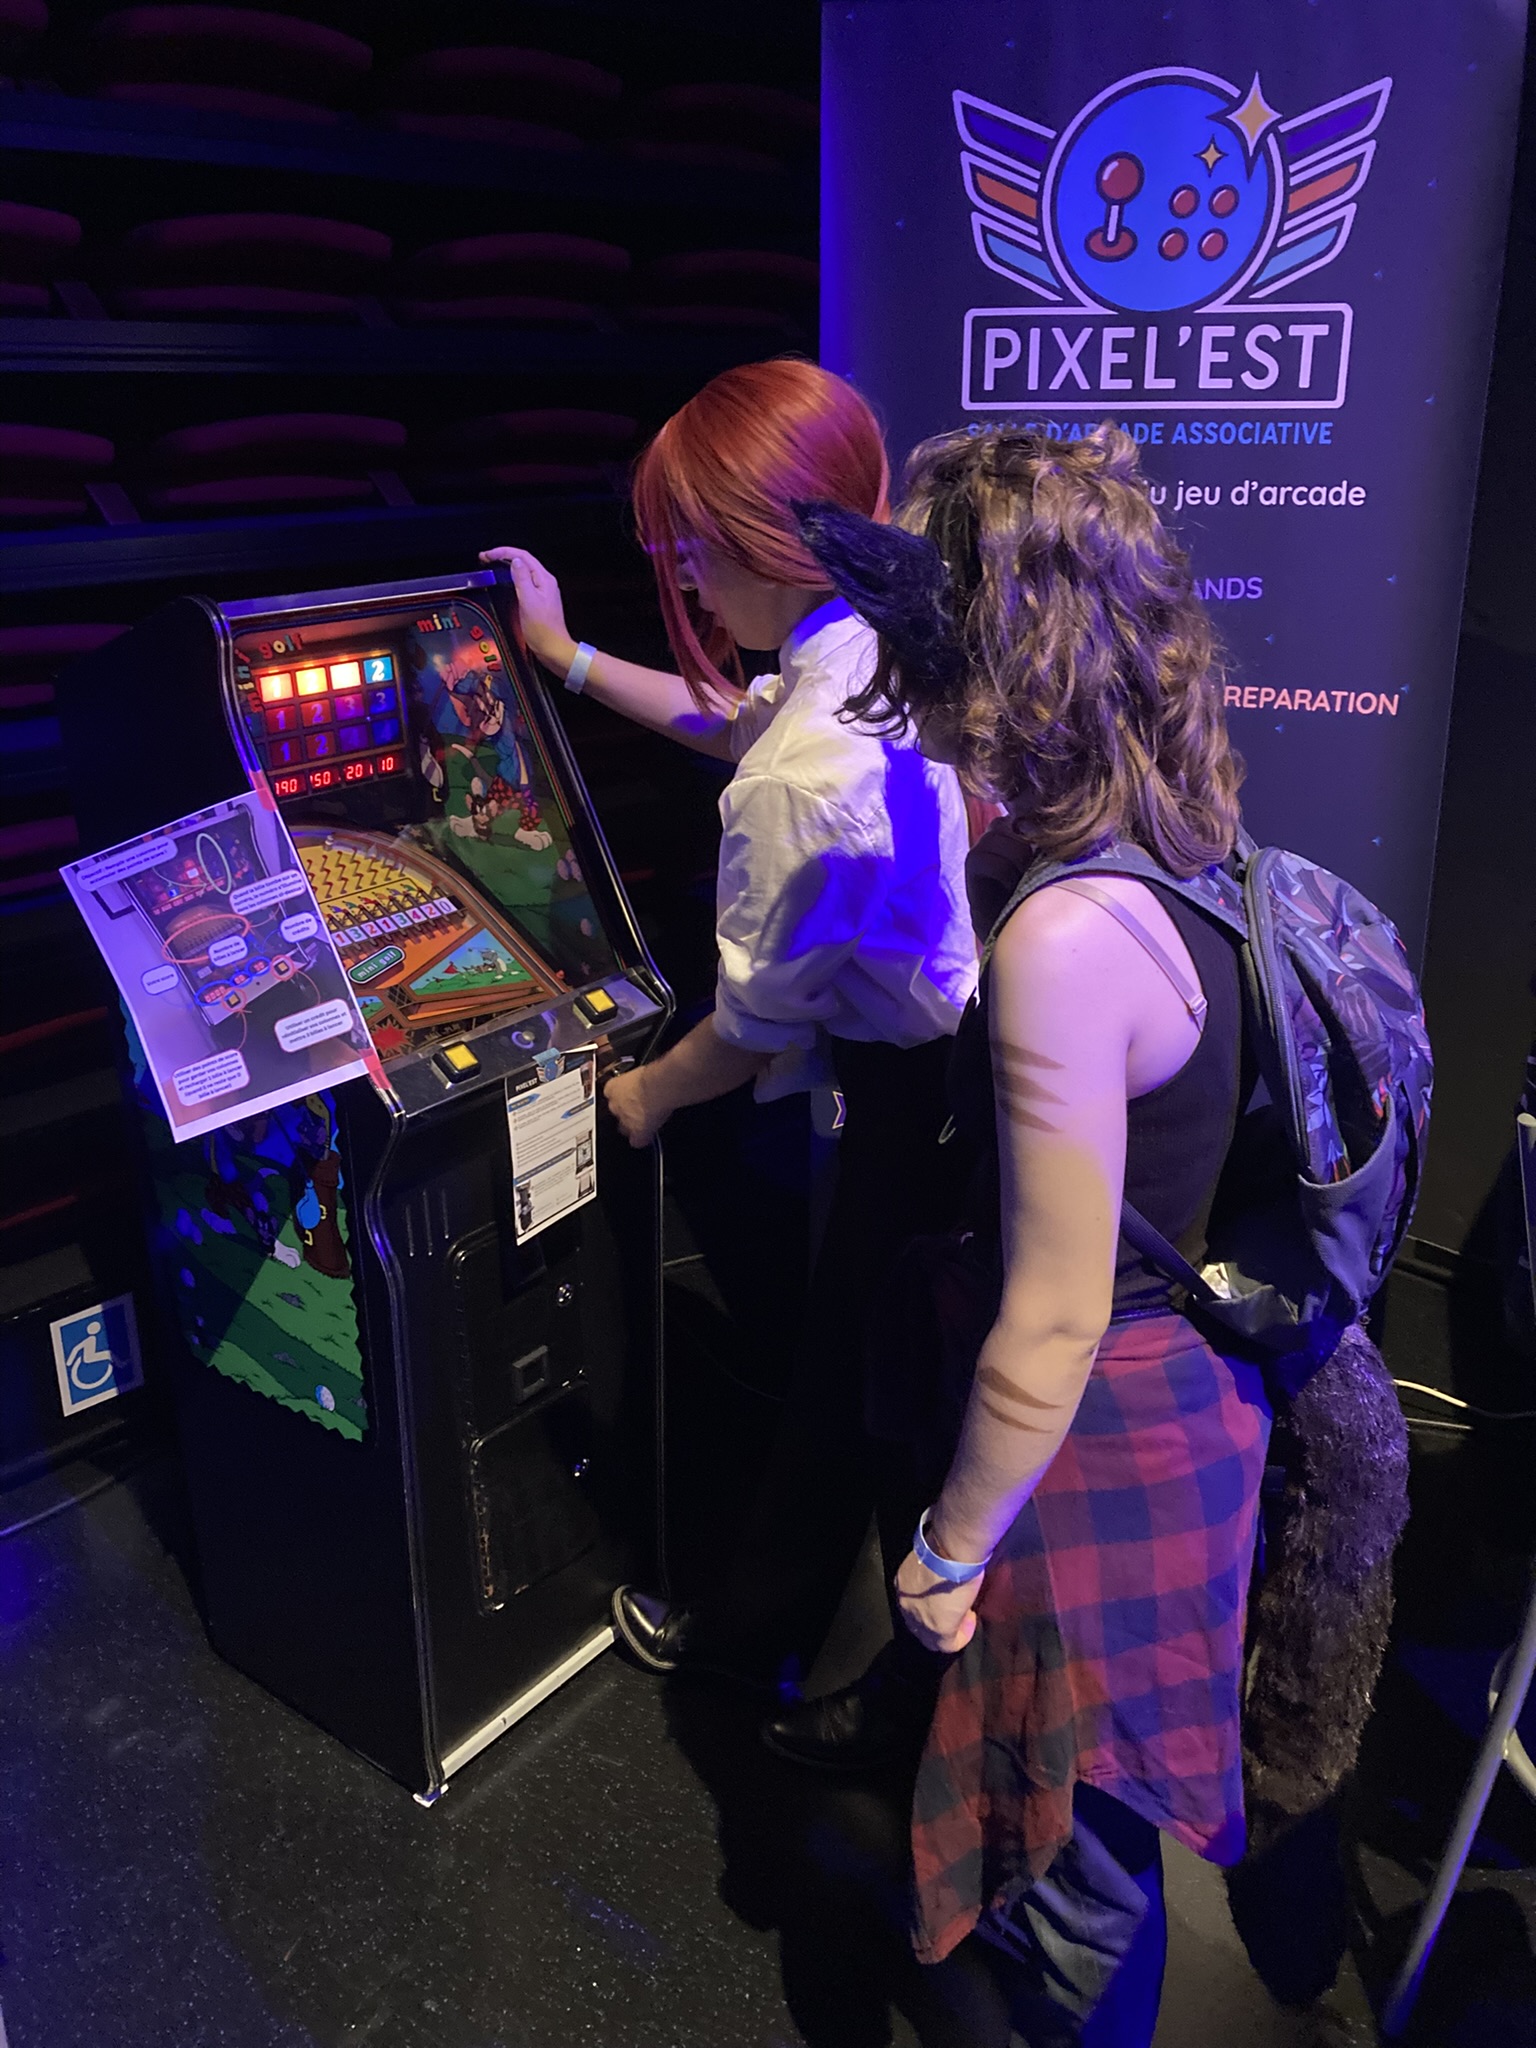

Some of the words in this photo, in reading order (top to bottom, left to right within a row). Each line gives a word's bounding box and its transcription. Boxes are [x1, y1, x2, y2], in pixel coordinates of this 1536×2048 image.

[984, 324, 1329, 390] PIXEL'EST
[1171, 422, 1333, 444] ASSOCIATIVE
[1174, 480, 1221, 511] jeu
[1230, 480, 1366, 506] d'arcade
[416, 611, 461, 632] mini
[258, 632, 303, 659] golf
[371, 660, 385, 681] 2
[1223, 685, 1399, 716] REPARATION
[276, 710, 286, 730] 1
[311, 703, 324, 723] 2
[280, 741, 290, 762] 1
[315, 735, 328, 755] 2
[349, 928, 362, 940] 3
[365, 923, 377, 935] 2
[382, 919, 391, 930] 1
[396, 914, 408, 926] 3
[411, 909, 421, 921] 4
[425, 905, 436, 916] 2
[357, 963, 377, 979] mini
